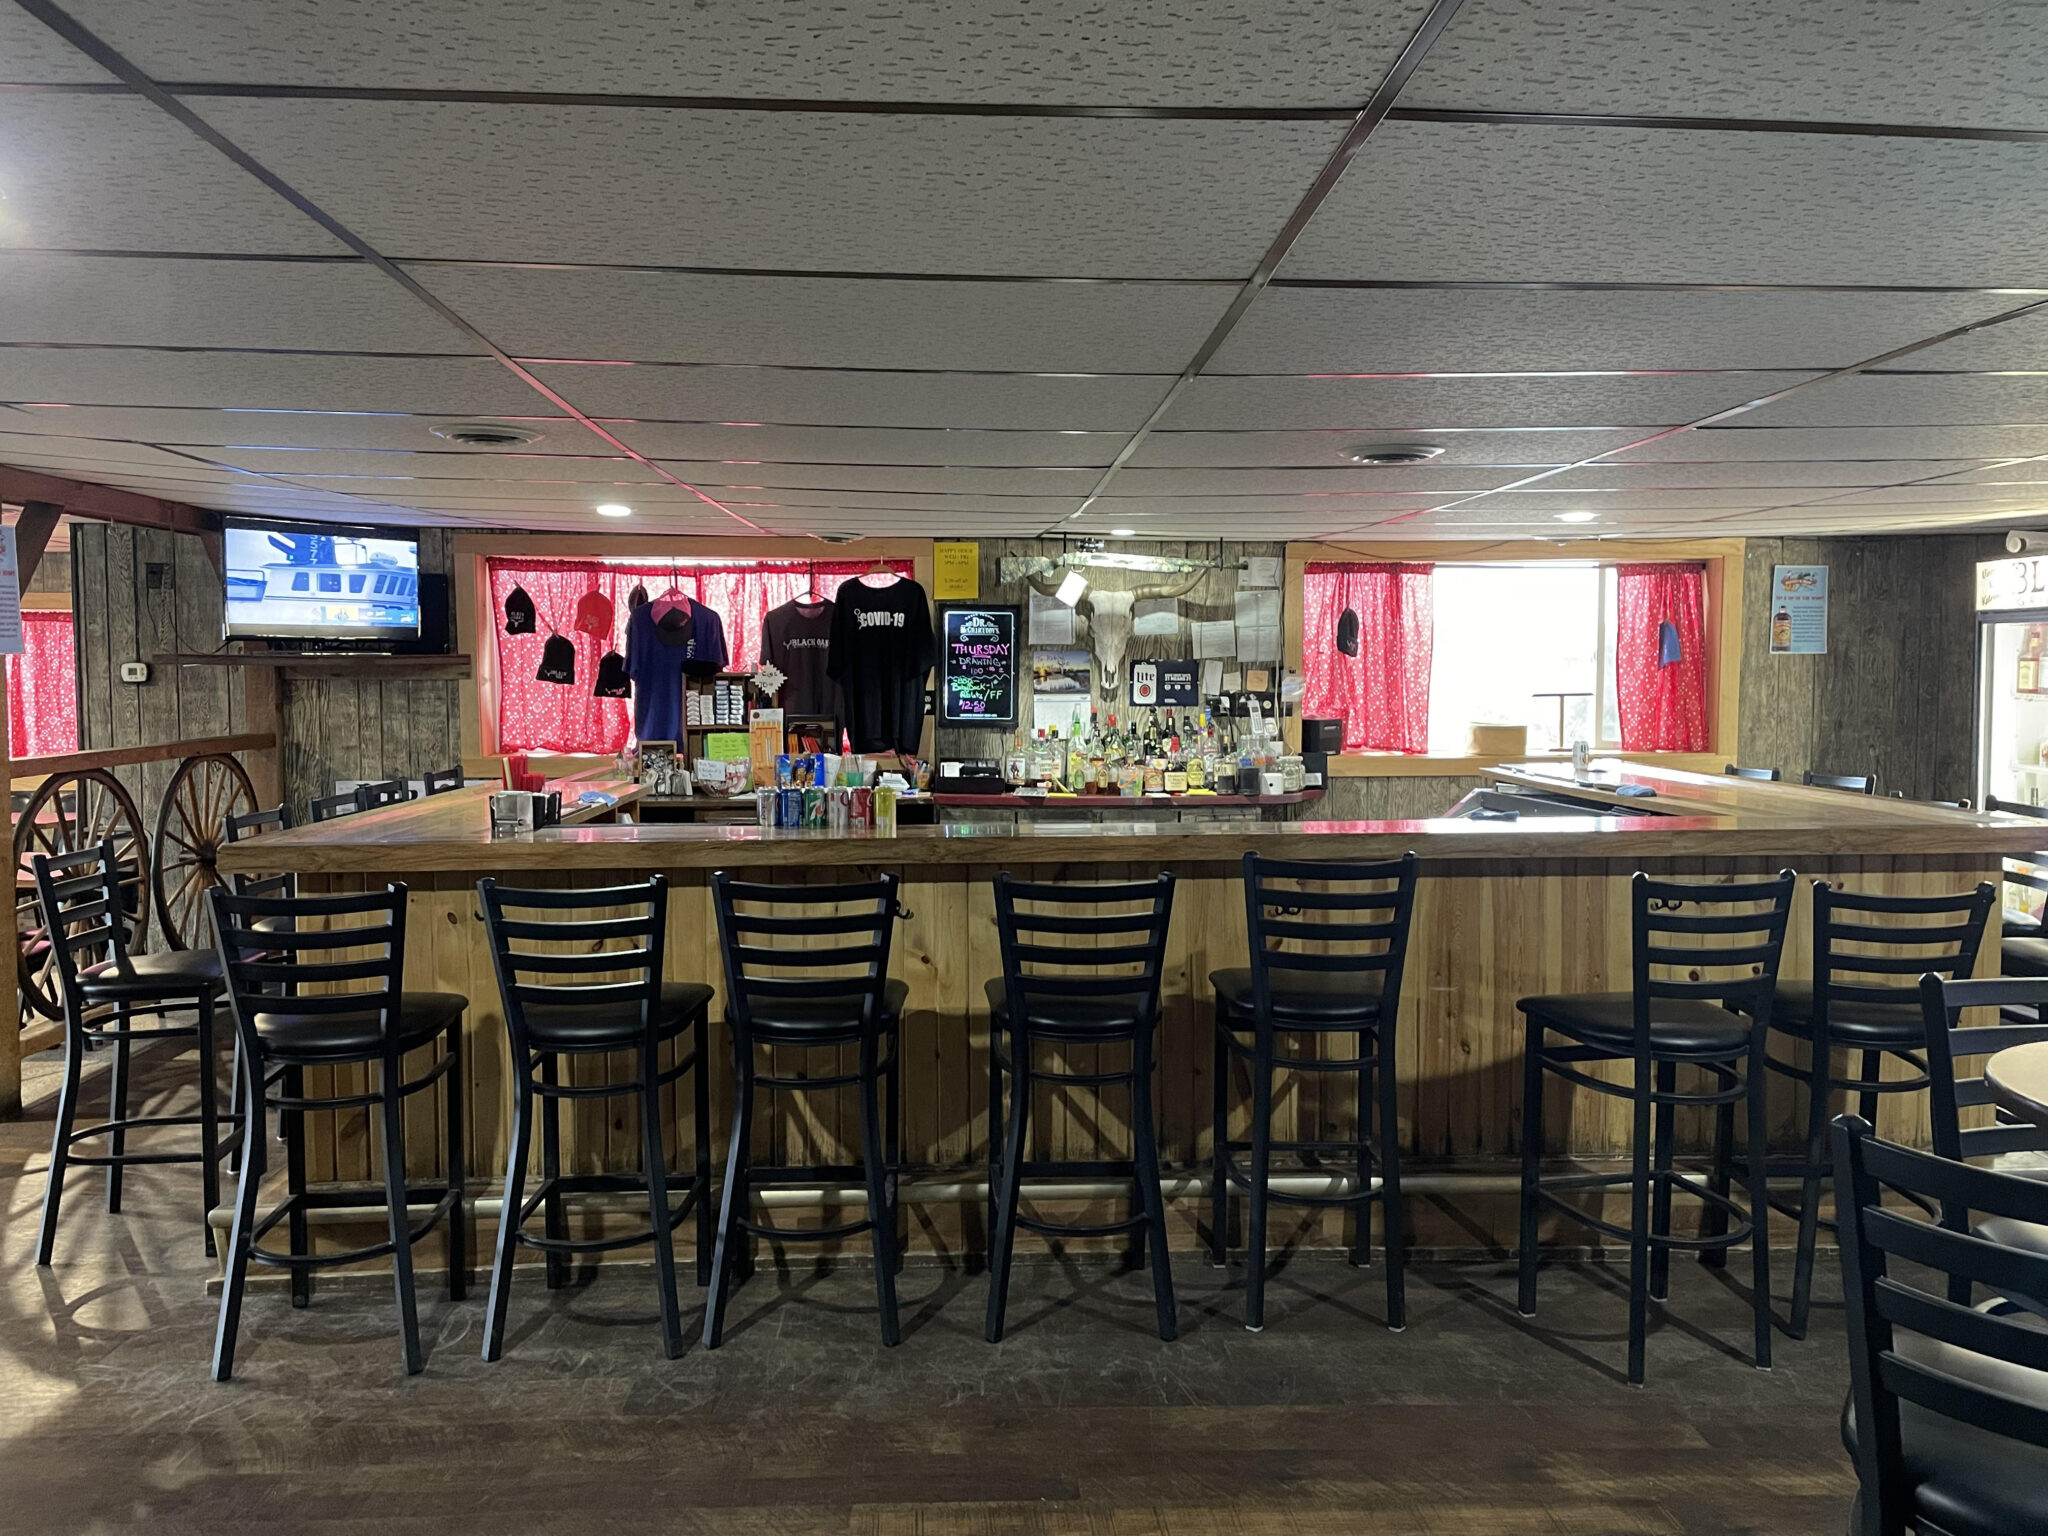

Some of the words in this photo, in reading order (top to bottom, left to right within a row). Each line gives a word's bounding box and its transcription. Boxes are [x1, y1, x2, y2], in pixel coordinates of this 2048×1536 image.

[859, 611, 905, 628] COVID-19
[951, 643, 1010, 656] THURSDAY
[958, 657, 1001, 668] DRAWING
[1136, 672, 1155, 684] Lite
